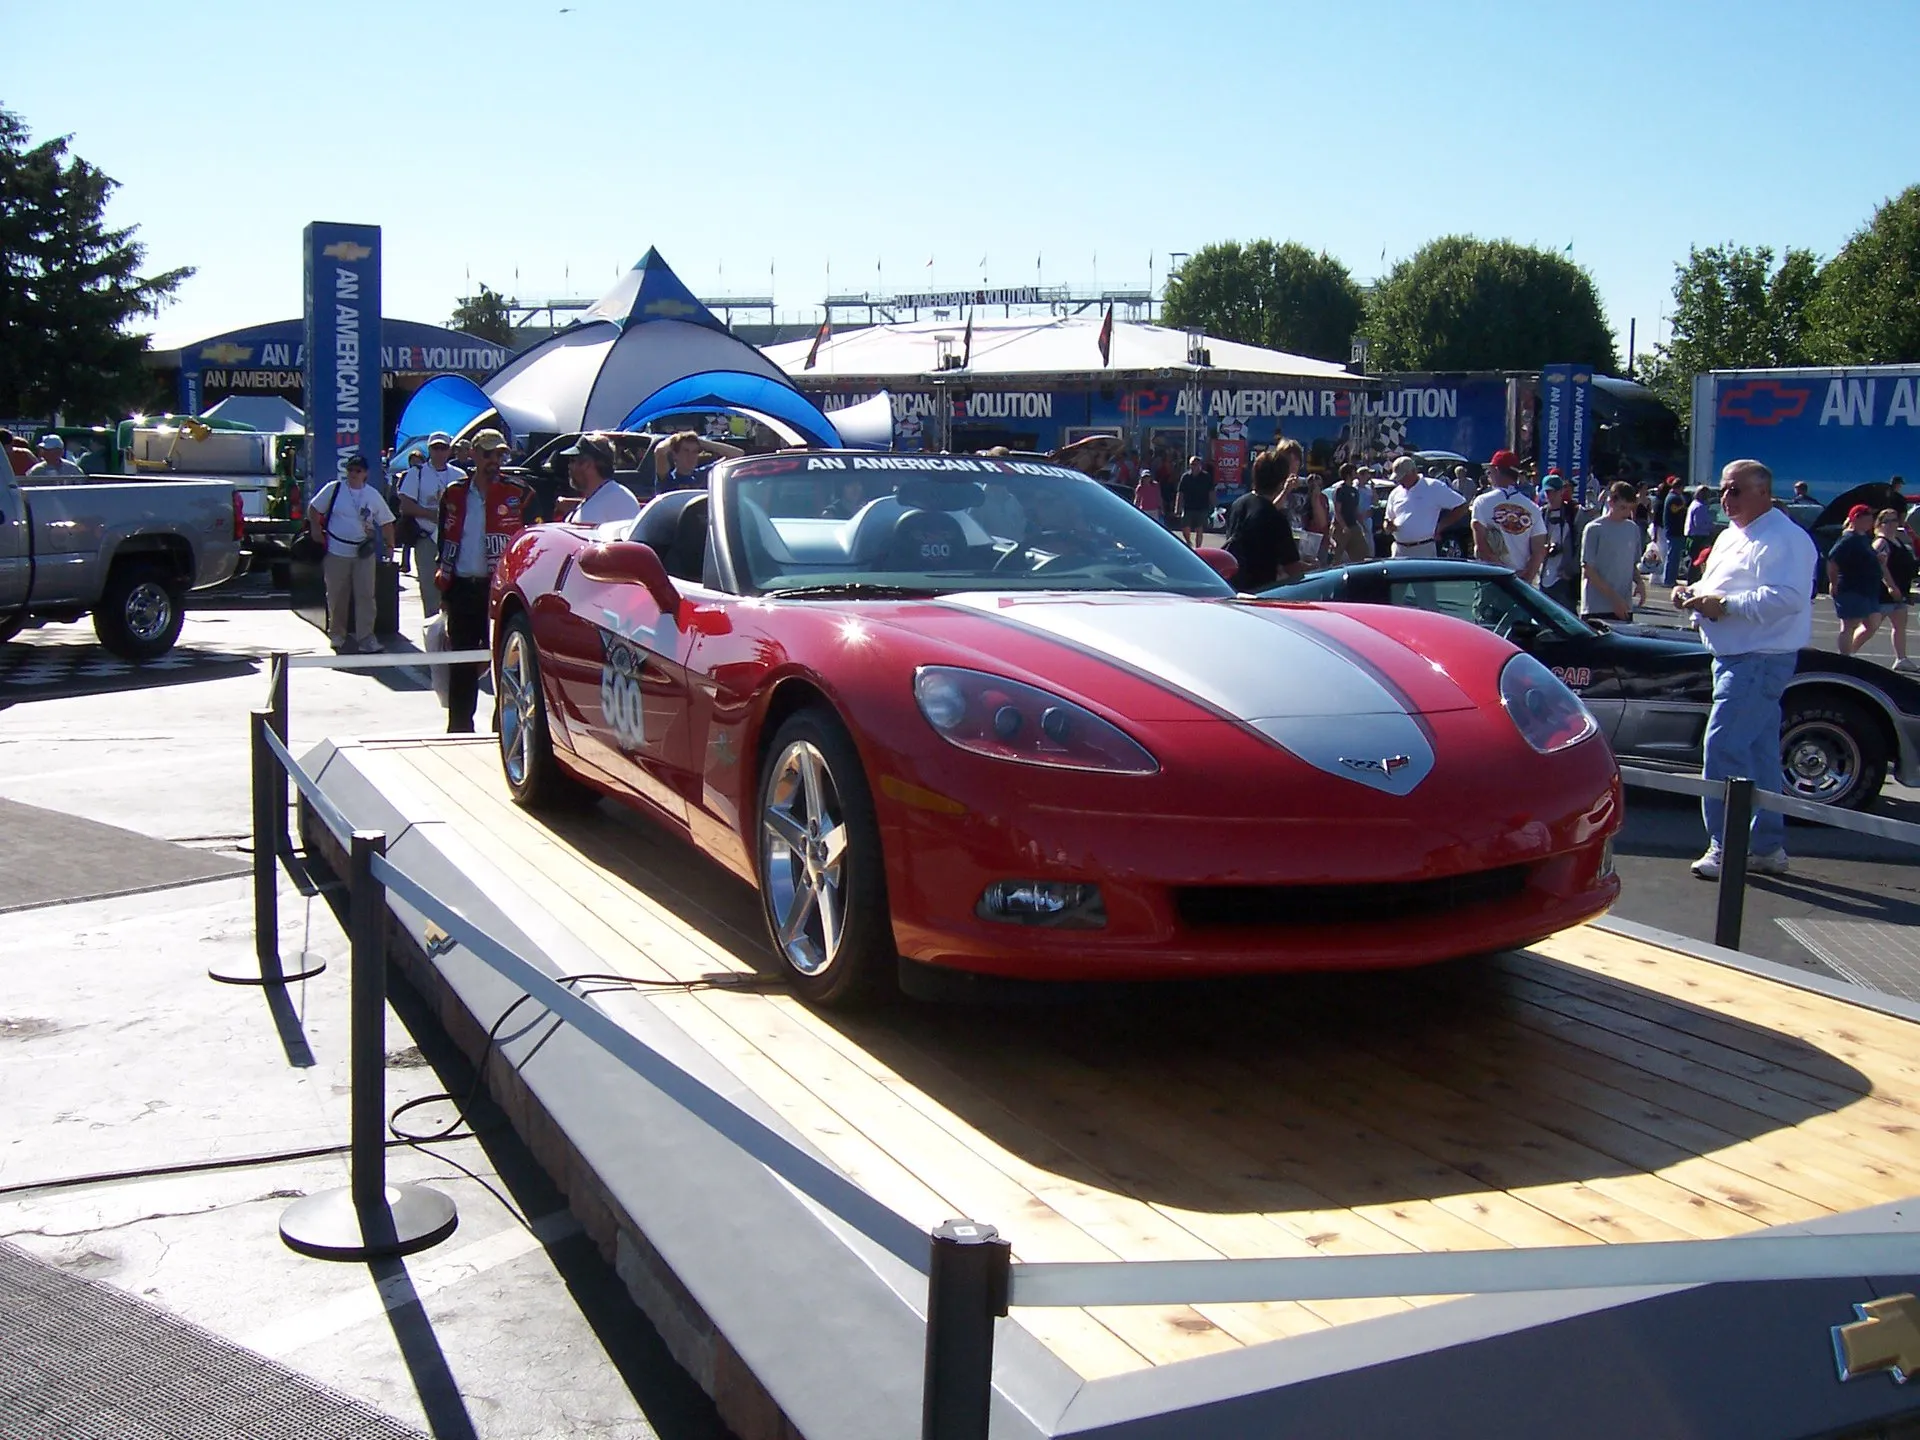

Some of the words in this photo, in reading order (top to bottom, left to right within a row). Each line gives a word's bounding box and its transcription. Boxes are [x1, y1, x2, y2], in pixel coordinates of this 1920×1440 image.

[335, 267, 359, 300] AN
[911, 292, 966, 307] AMERICAN
[967, 287, 1037, 304] REVOLUTION
[260, 343, 289, 366] AN
[398, 346, 505, 370] REVOLUTION
[335, 303, 360, 412] AMERICAN
[204, 370, 226, 388] AN
[823, 394, 845, 413] AN
[851, 393, 937, 421] ARICAN
[1174, 389, 1203, 416] AN
[1207, 389, 1314, 417] AMERICAN
[1320, 388, 1457, 418] REVOLUTION
[1550, 386, 1560, 402] AN
[1575, 386, 1584, 402] AN
[1819, 379, 1876, 426] AN
[1548, 404, 1560, 459] AMERICAN
[1572, 404, 1583, 459] AMERICAN
[807, 457, 847, 471] AN
[854, 457, 979, 473] AMERICAN
[920, 544, 950, 557] 500
[1551, 666, 1591, 686] CAR
[601, 664, 646, 746] 500
